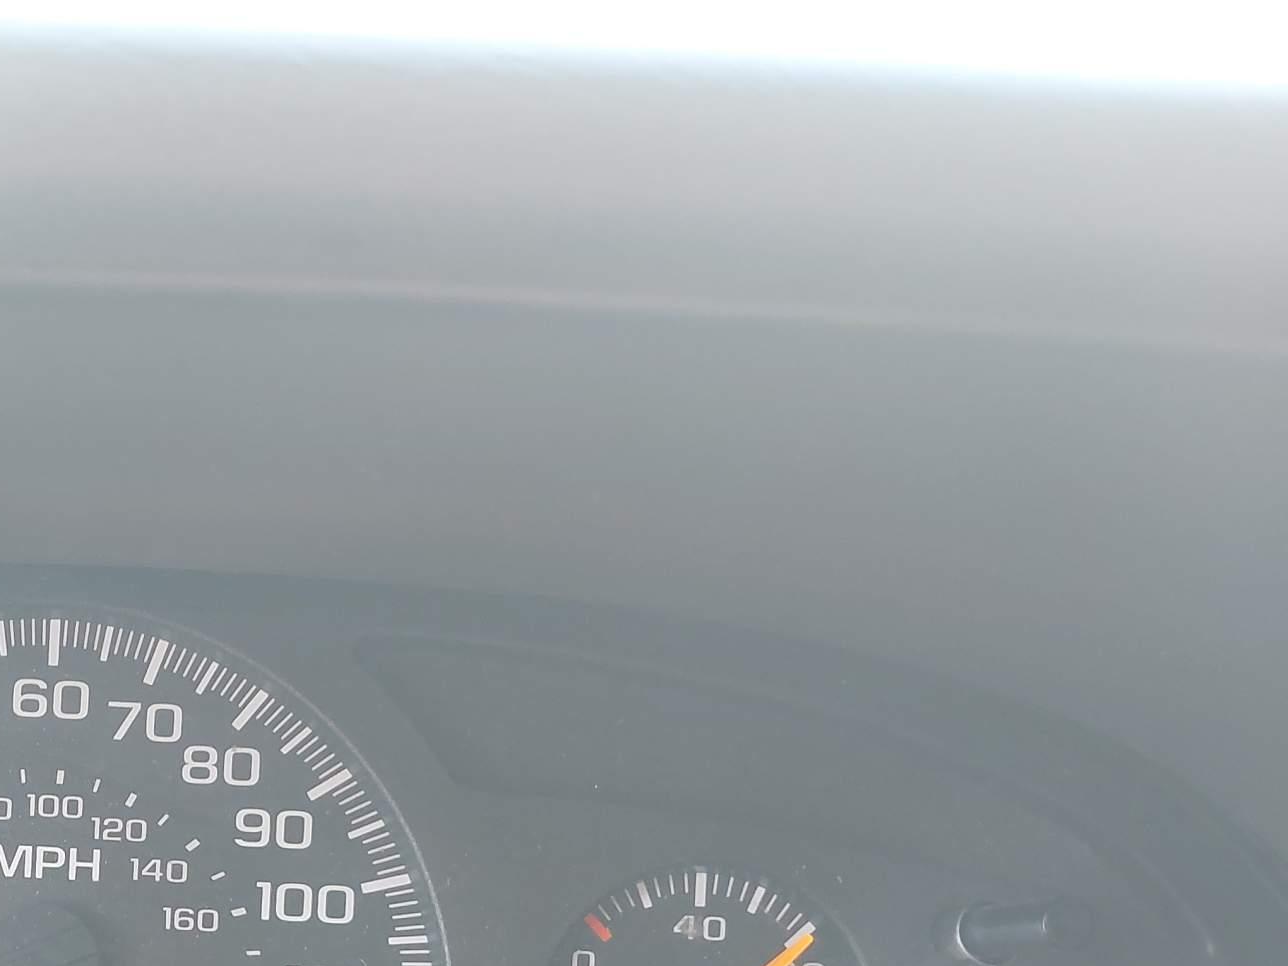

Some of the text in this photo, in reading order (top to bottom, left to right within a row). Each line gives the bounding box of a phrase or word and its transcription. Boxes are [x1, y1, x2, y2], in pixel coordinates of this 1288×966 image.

[12, 678, 89, 720] 60
[108, 701, 183, 743] 70
[181, 745, 261, 786] 80
[27, 794, 83, 819] 100
[91, 816, 147, 842] 120
[234, 808, 312, 850] 90
[130, 857, 188, 883] 140
[162, 906, 219, 932] 160
[256, 882, 355, 924] 100
[673, 915, 726, 941] 40
